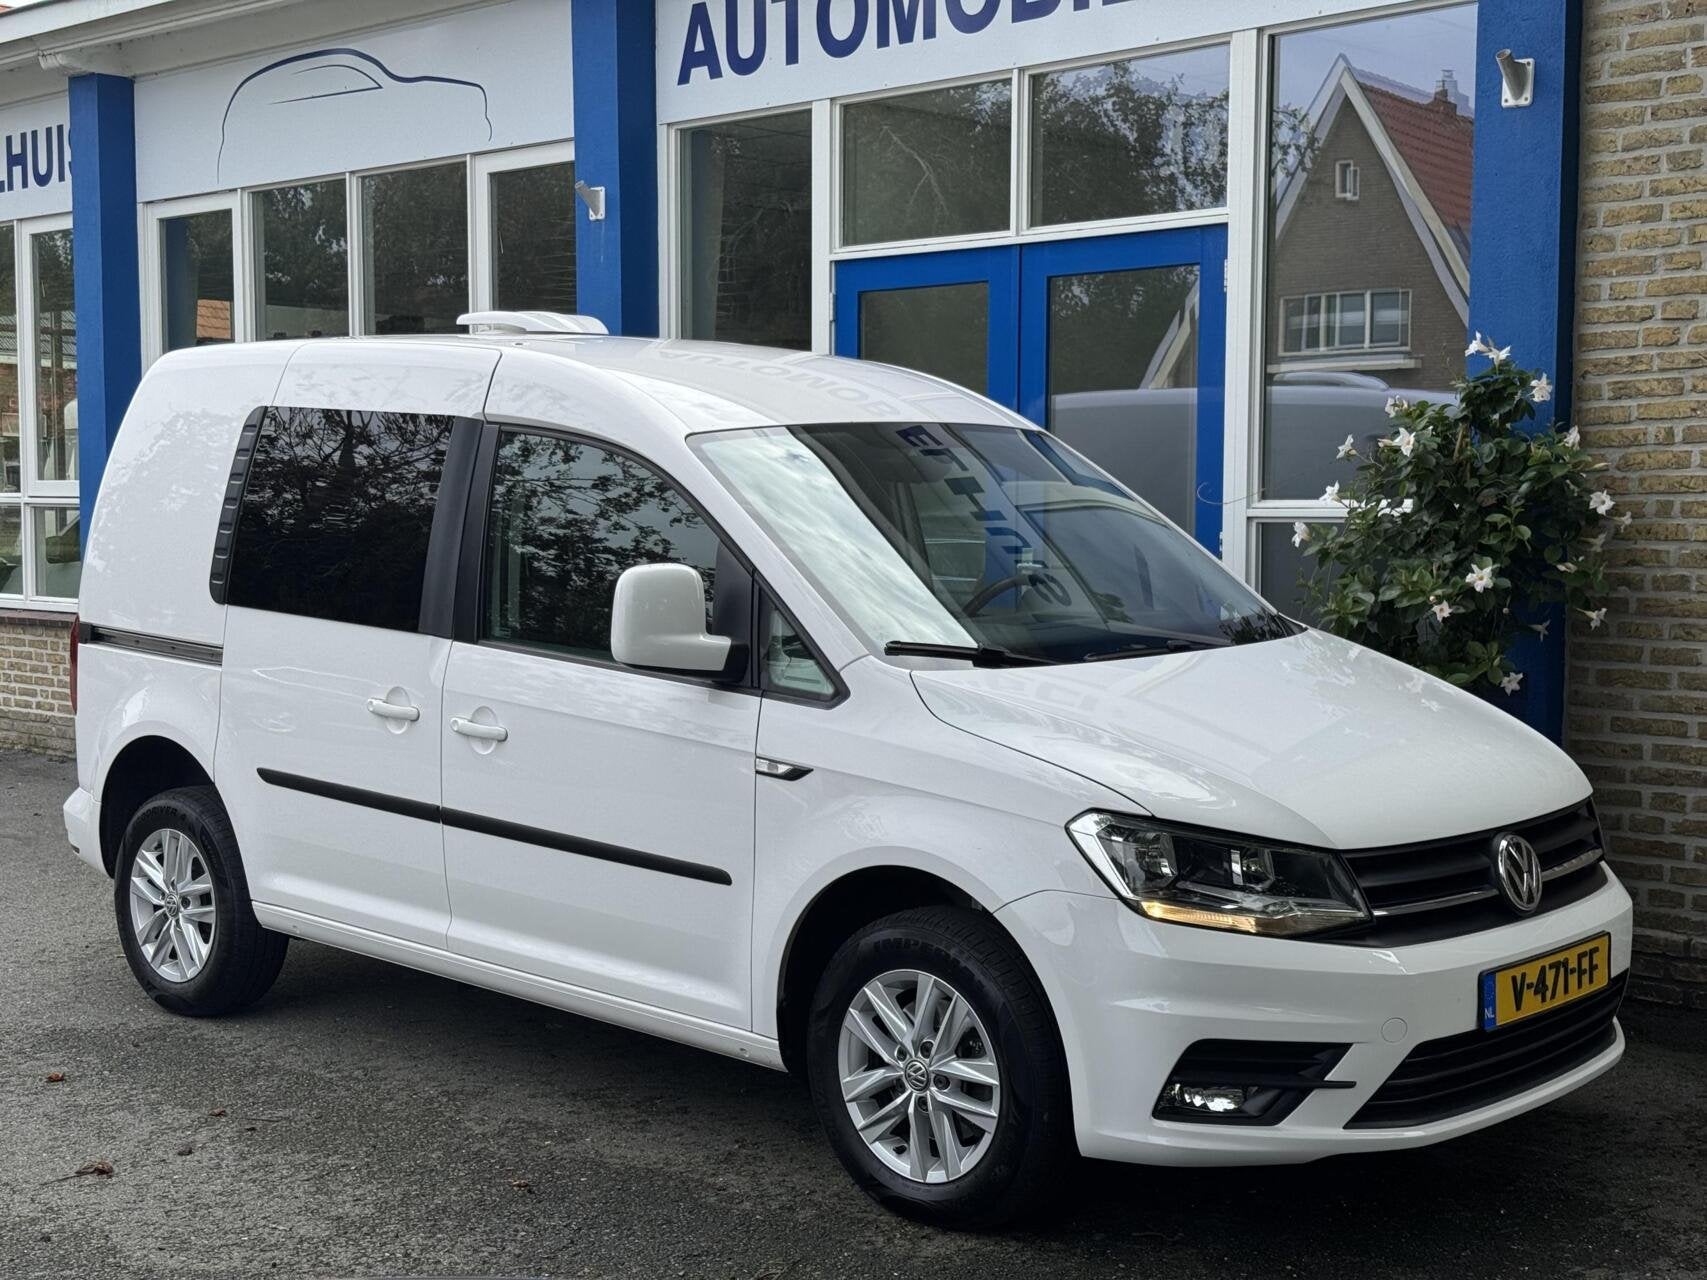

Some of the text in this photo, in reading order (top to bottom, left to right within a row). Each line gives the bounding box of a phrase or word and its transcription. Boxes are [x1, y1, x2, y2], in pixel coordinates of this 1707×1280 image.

[677, 0, 1137, 86] AUTOM
[0, 124, 71, 193] HUI
[1511, 946, 1600, 1012] V-471-FF
[1484, 1006, 1495, 1020] NL
